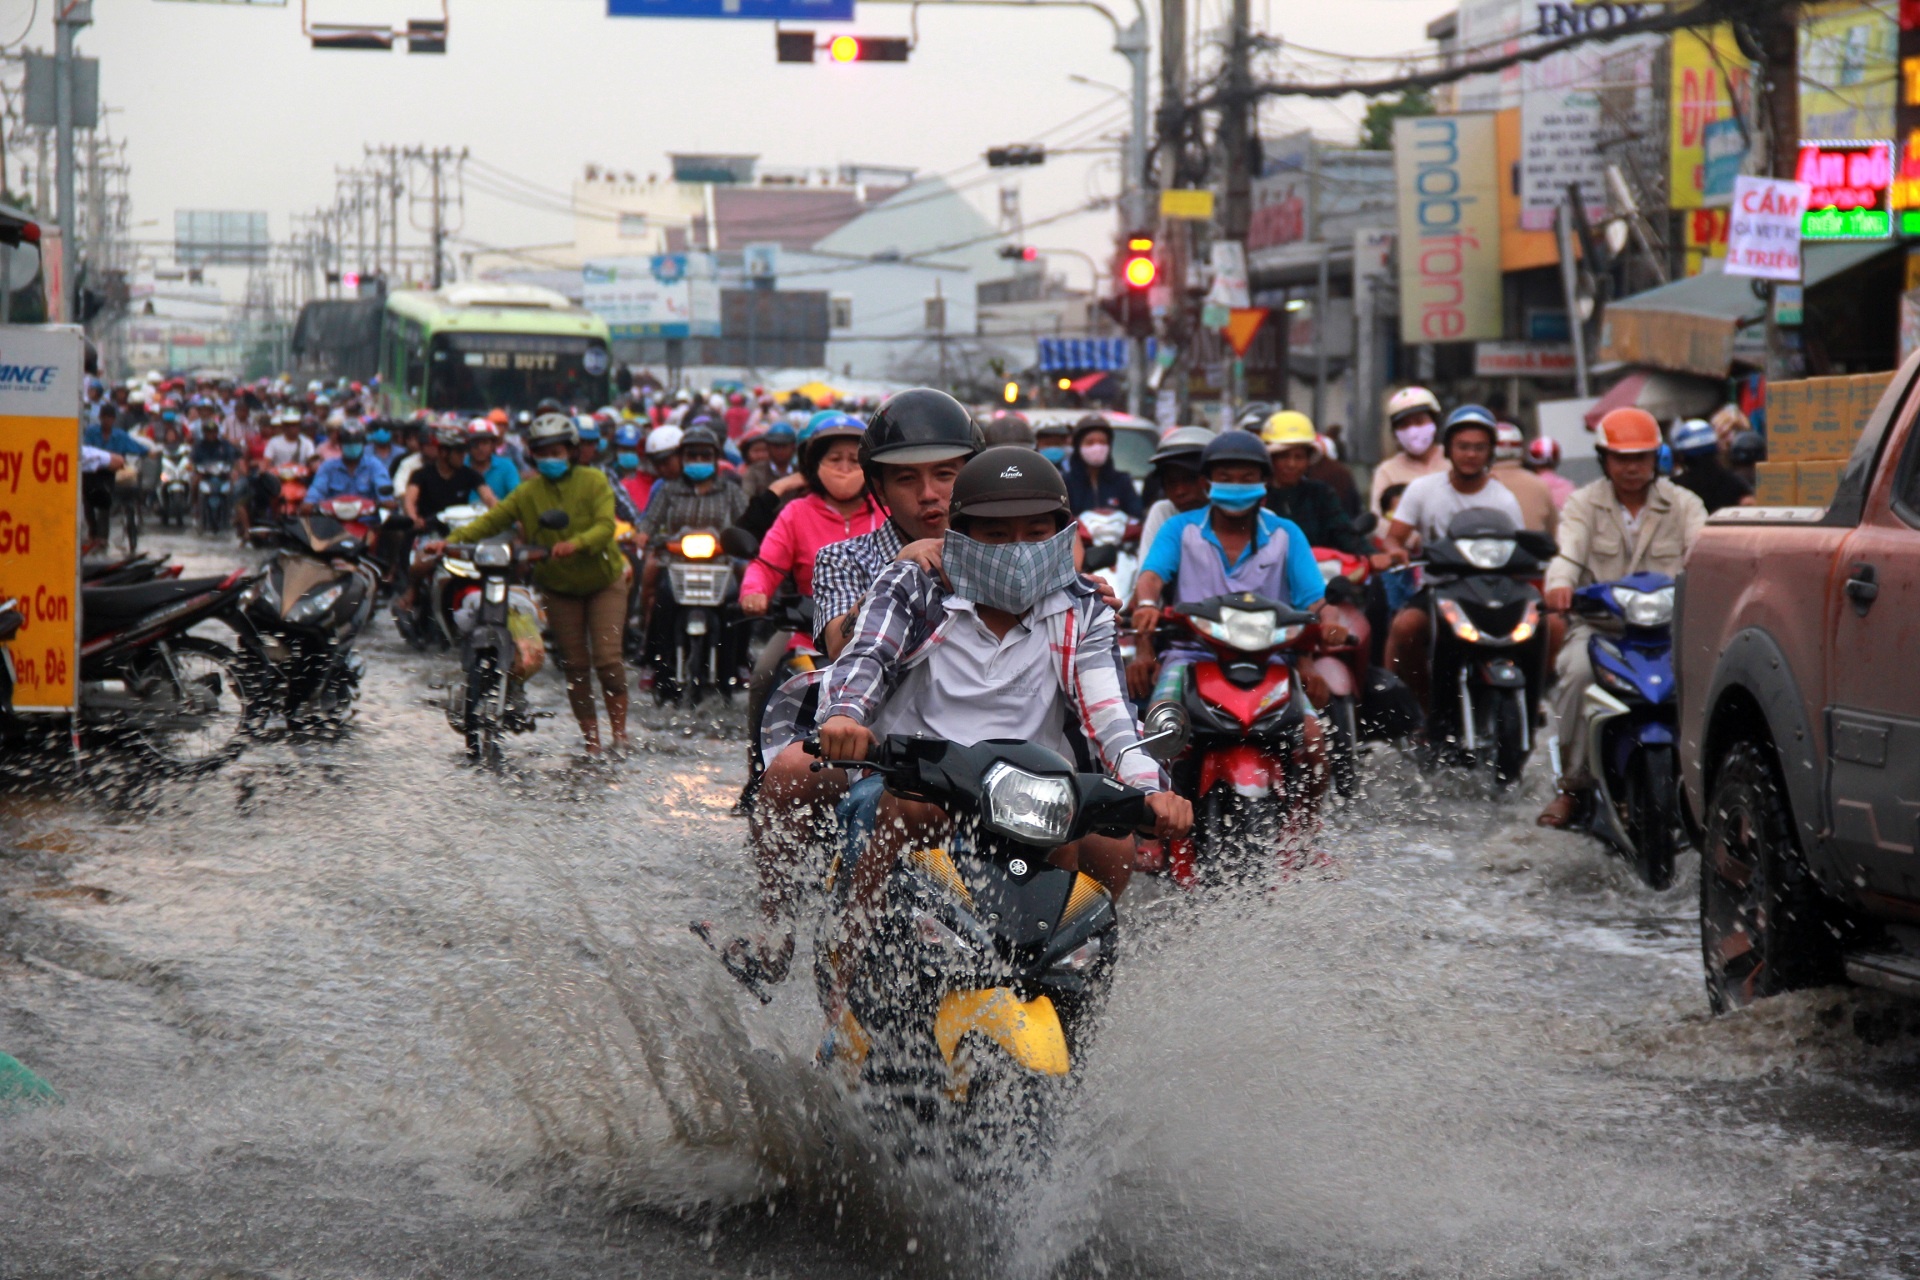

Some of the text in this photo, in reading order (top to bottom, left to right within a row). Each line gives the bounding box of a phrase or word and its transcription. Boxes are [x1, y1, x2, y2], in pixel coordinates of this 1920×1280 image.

[1415, 118, 1482, 340] mobifone
[33, 439, 69, 484] Ga
[0, 510, 30, 554] Ga
[35, 584, 68, 622] Con
